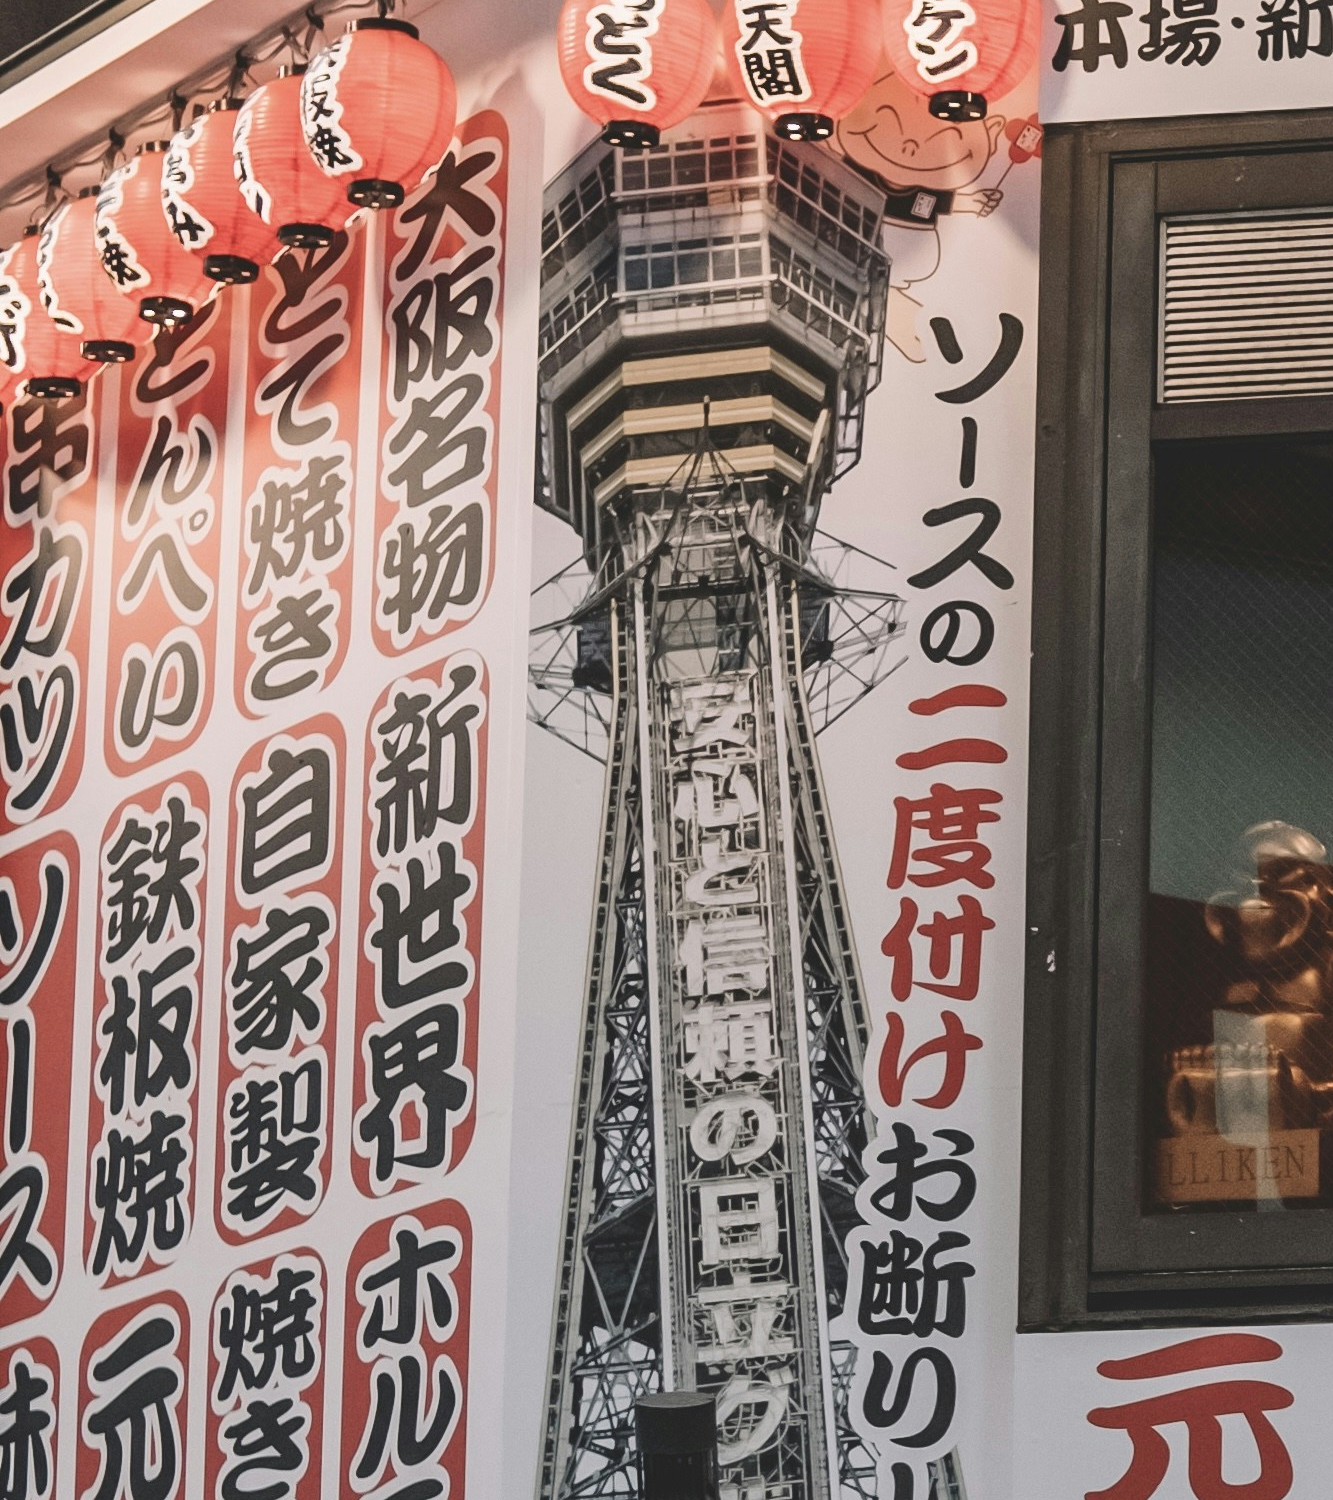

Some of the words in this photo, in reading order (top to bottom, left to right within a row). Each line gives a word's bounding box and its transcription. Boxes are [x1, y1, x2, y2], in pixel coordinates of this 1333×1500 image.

[0, 398, 91, 812] 串カツ
[382, 150, 500, 630] 大阪名物
[92, 796, 203, 1276] 鉄板焼
[224, 747, 333, 1222] 自家製
[362, 664, 478, 1183] 新世界
